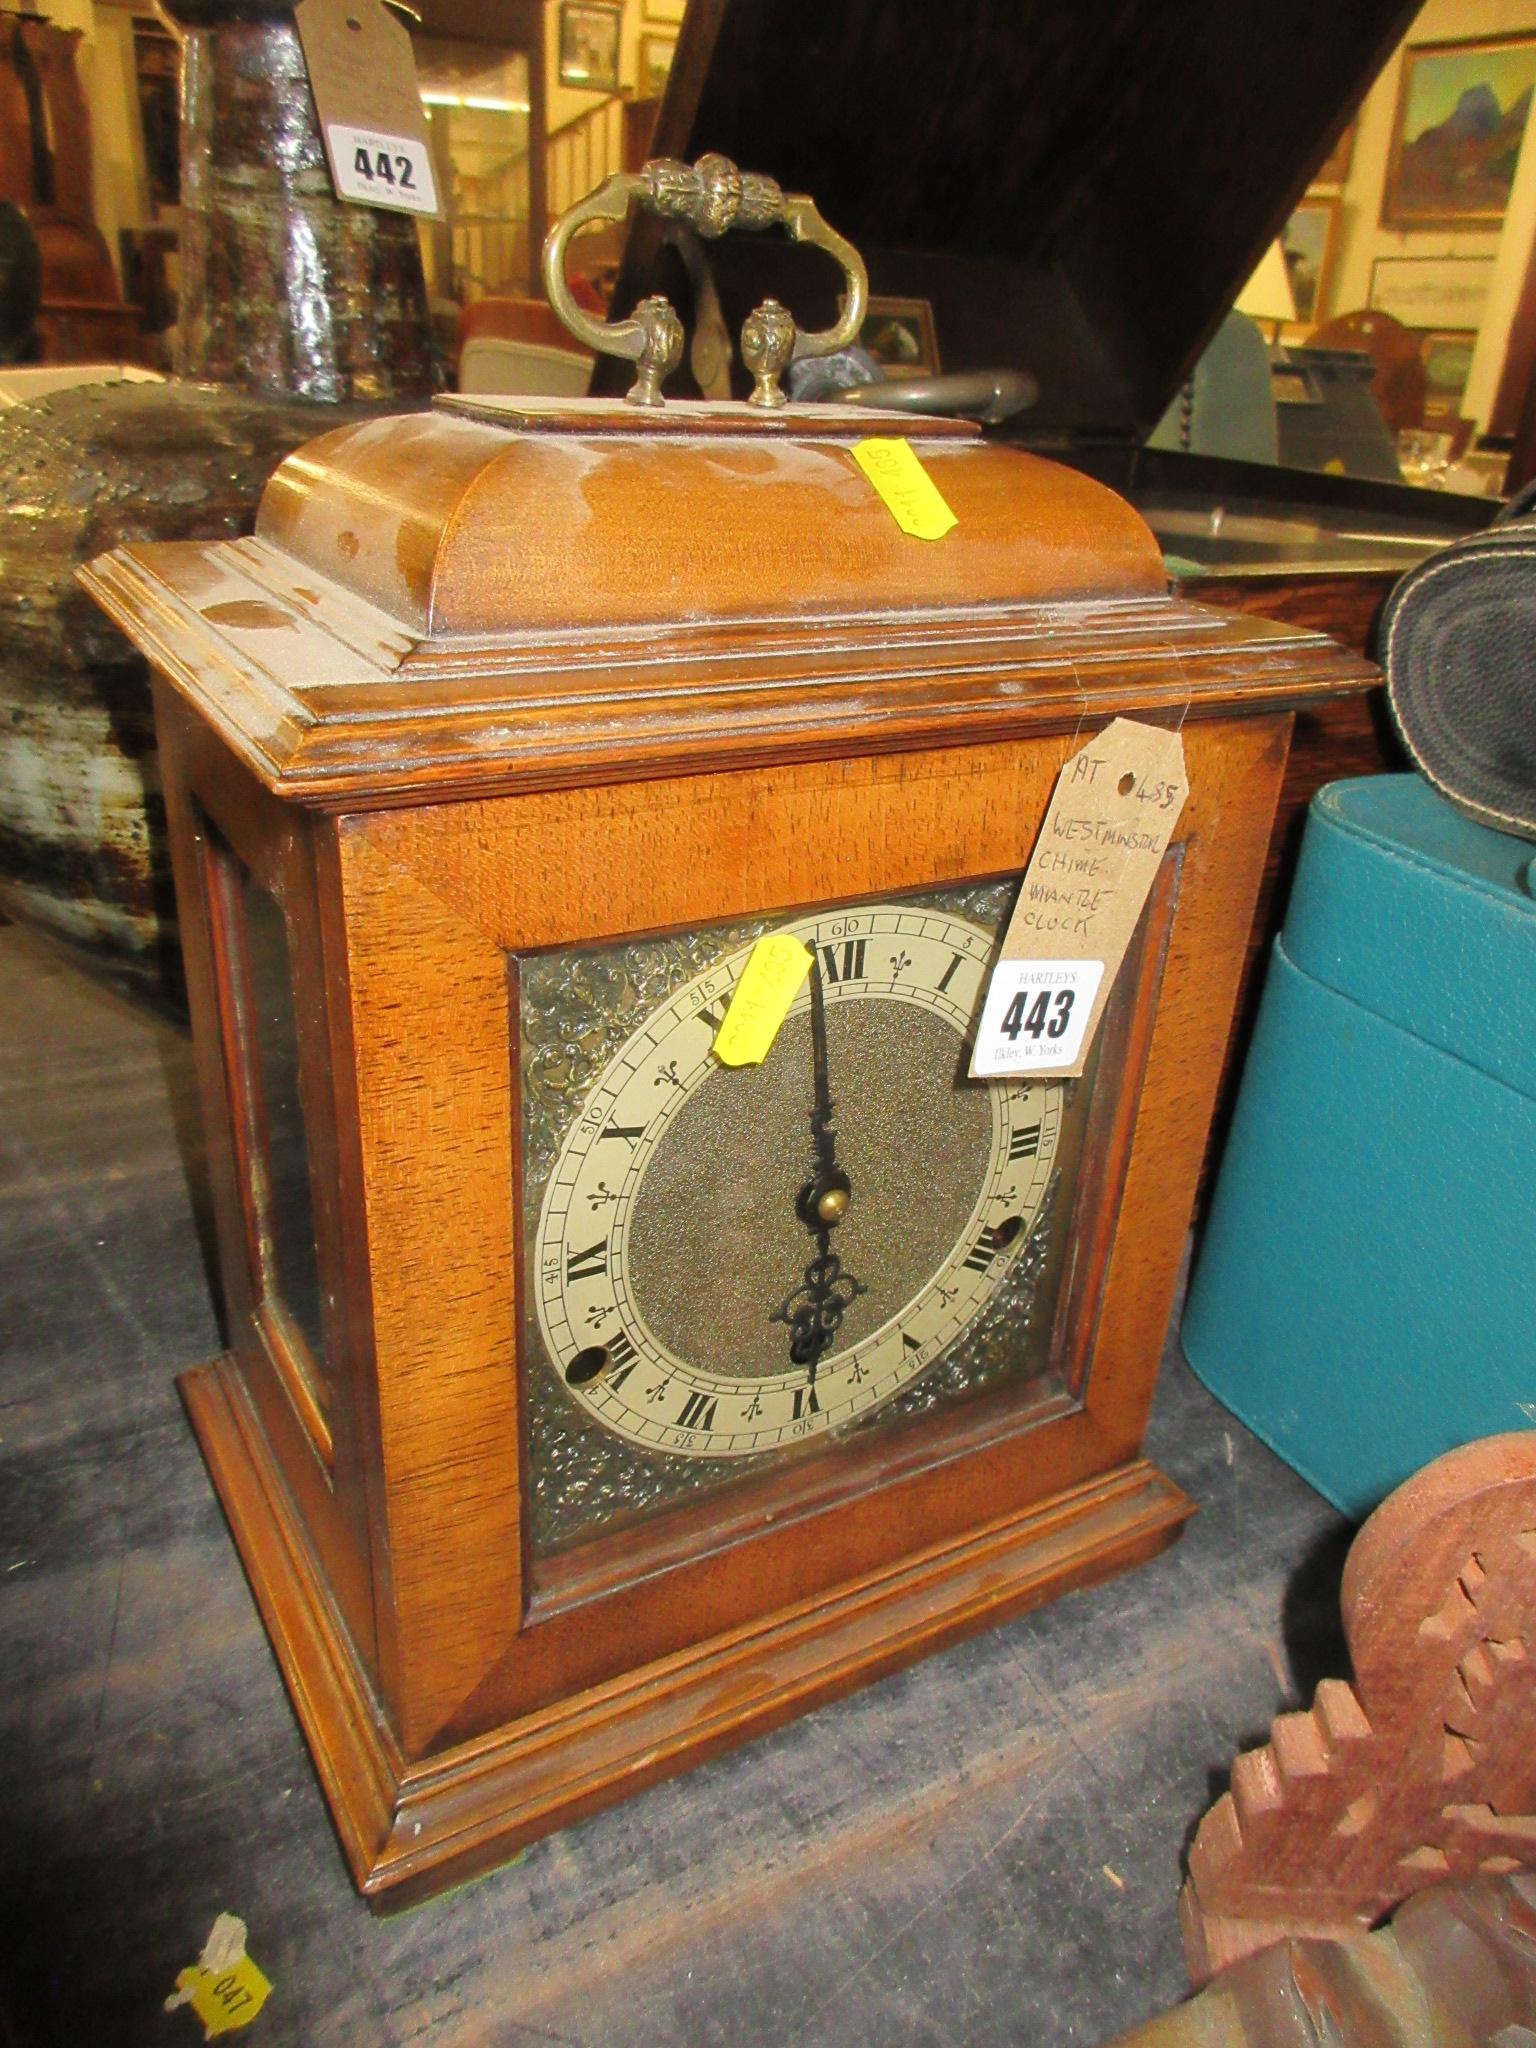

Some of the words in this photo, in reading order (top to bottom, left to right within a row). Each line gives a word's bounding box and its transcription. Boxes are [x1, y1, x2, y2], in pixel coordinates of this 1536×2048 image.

[354, 147, 417, 190] 442
[1071, 754, 1109, 785] AT
[831, 919, 859, 936] 60
[1023, 911, 1096, 937] CLOCK
[962, 936, 974, 949] 5
[1018, 971, 1078, 985] HARTLEYS
[690, 979, 716, 1006] 55
[1000, 989, 1076, 1041] 443
[1038, 1042, 1064, 1057] Yorks
[581, 1107, 604, 1136] 50
[596, 1109, 650, 1154] X
